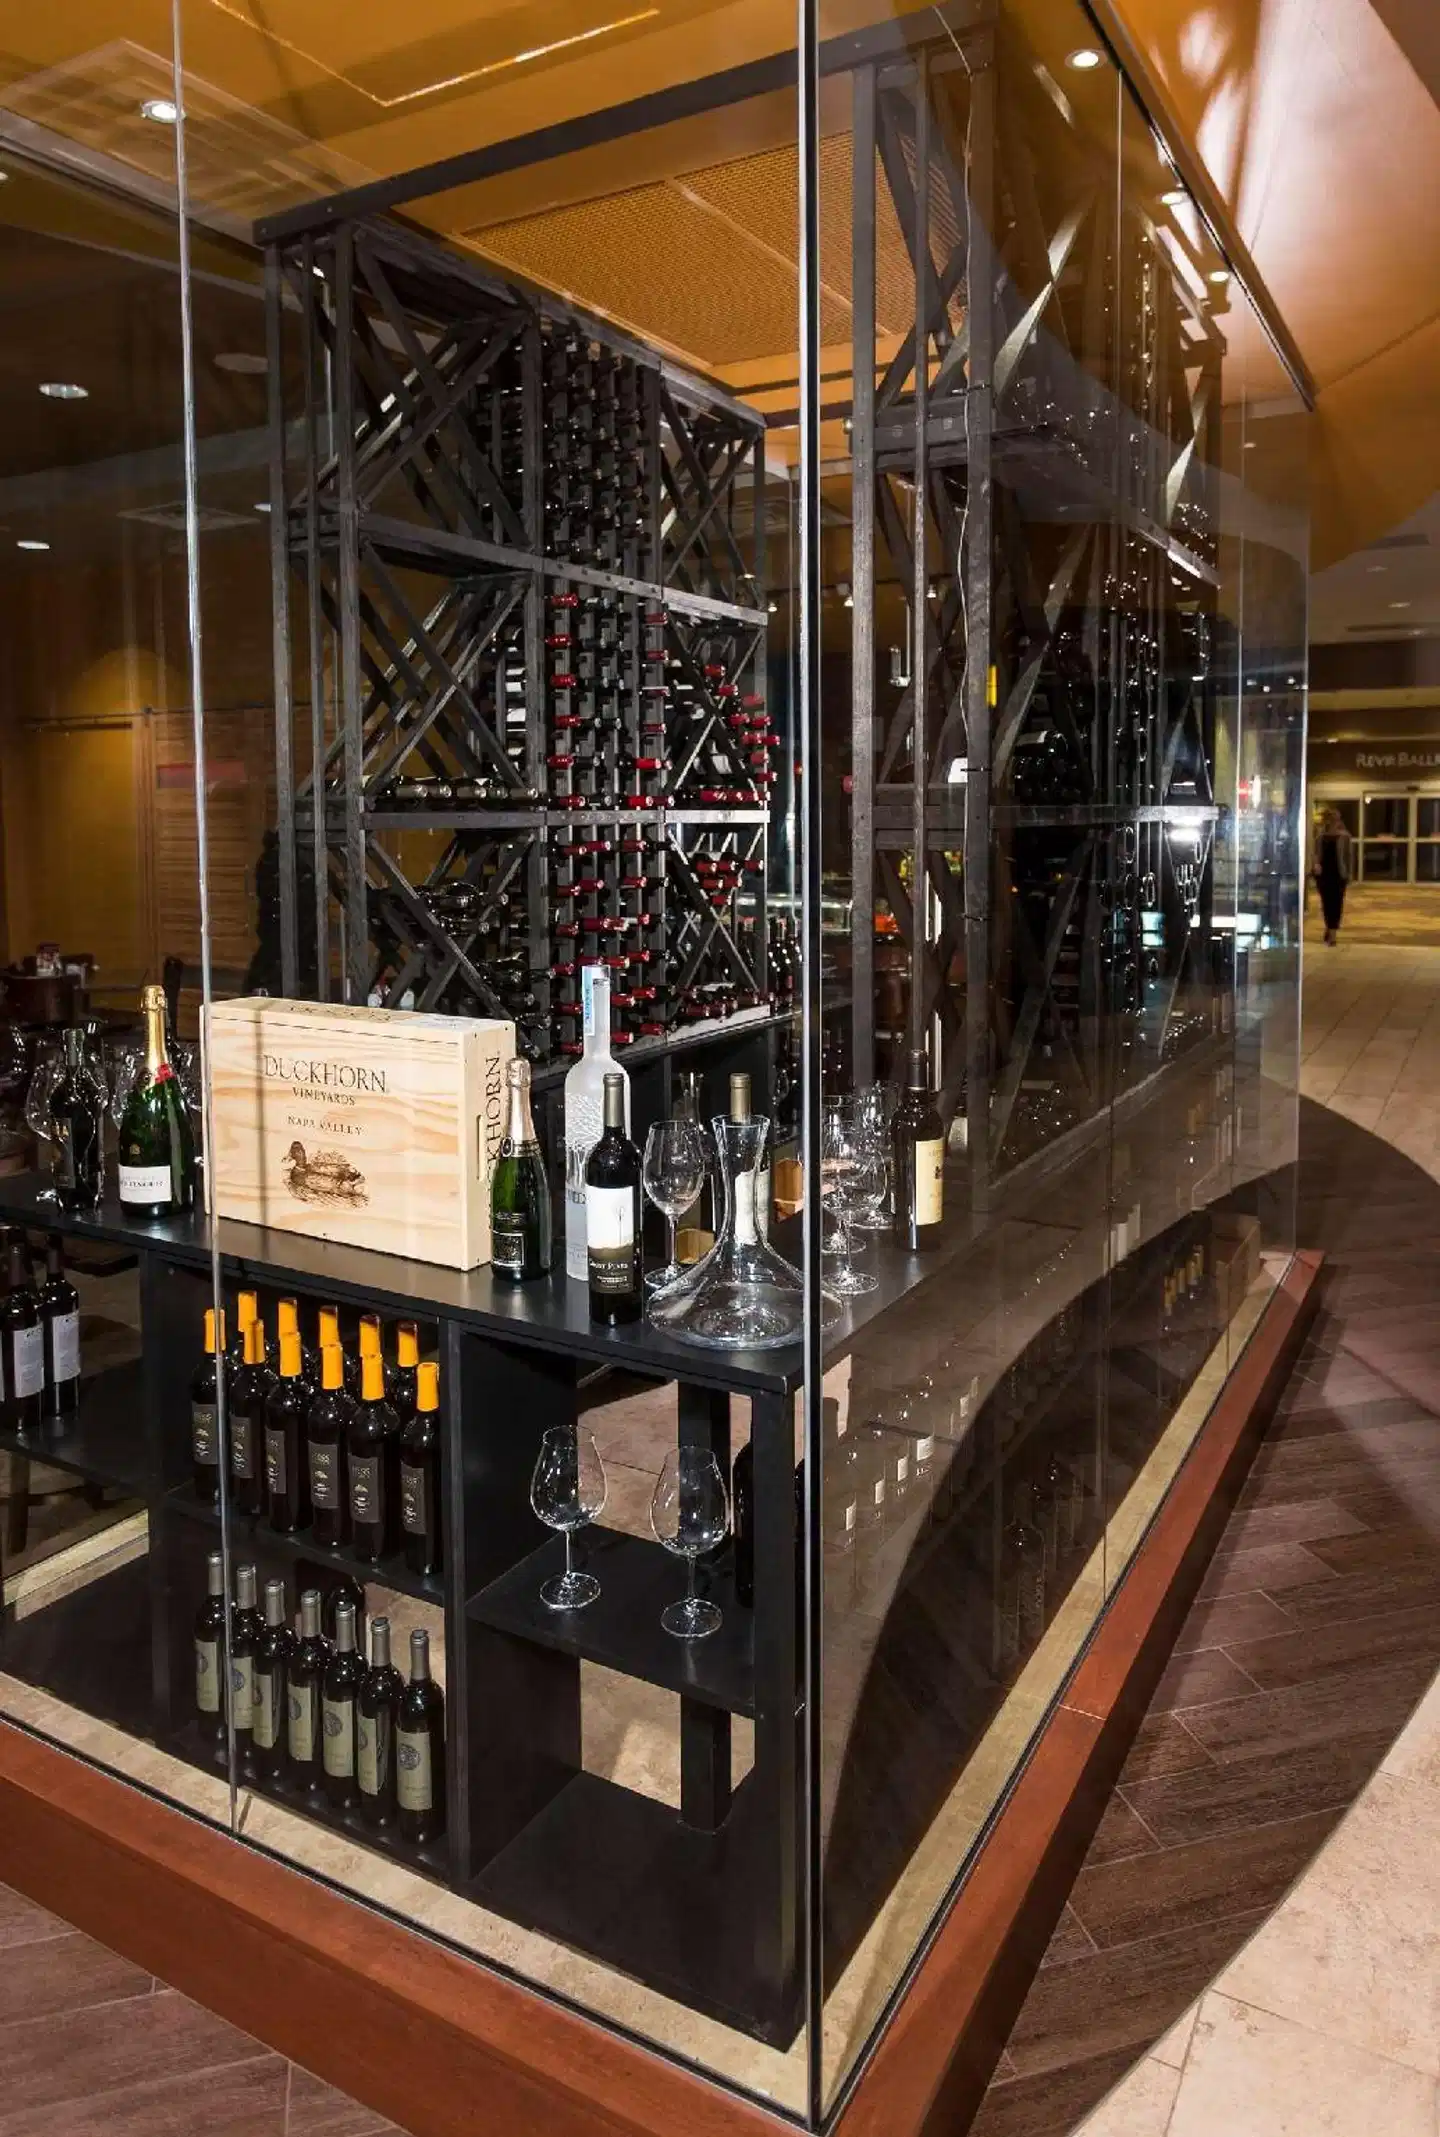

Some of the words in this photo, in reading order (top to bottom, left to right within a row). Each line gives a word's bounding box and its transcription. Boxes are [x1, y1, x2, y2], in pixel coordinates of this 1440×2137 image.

[263, 1054, 387, 1093] DUCKHORN
[292, 1086, 356, 1106] VINEYARDS
[287, 1115, 316, 1128] NAPA
[319, 1120, 363, 1136] VALLEY
[485, 1057, 501, 1172] KHORN
